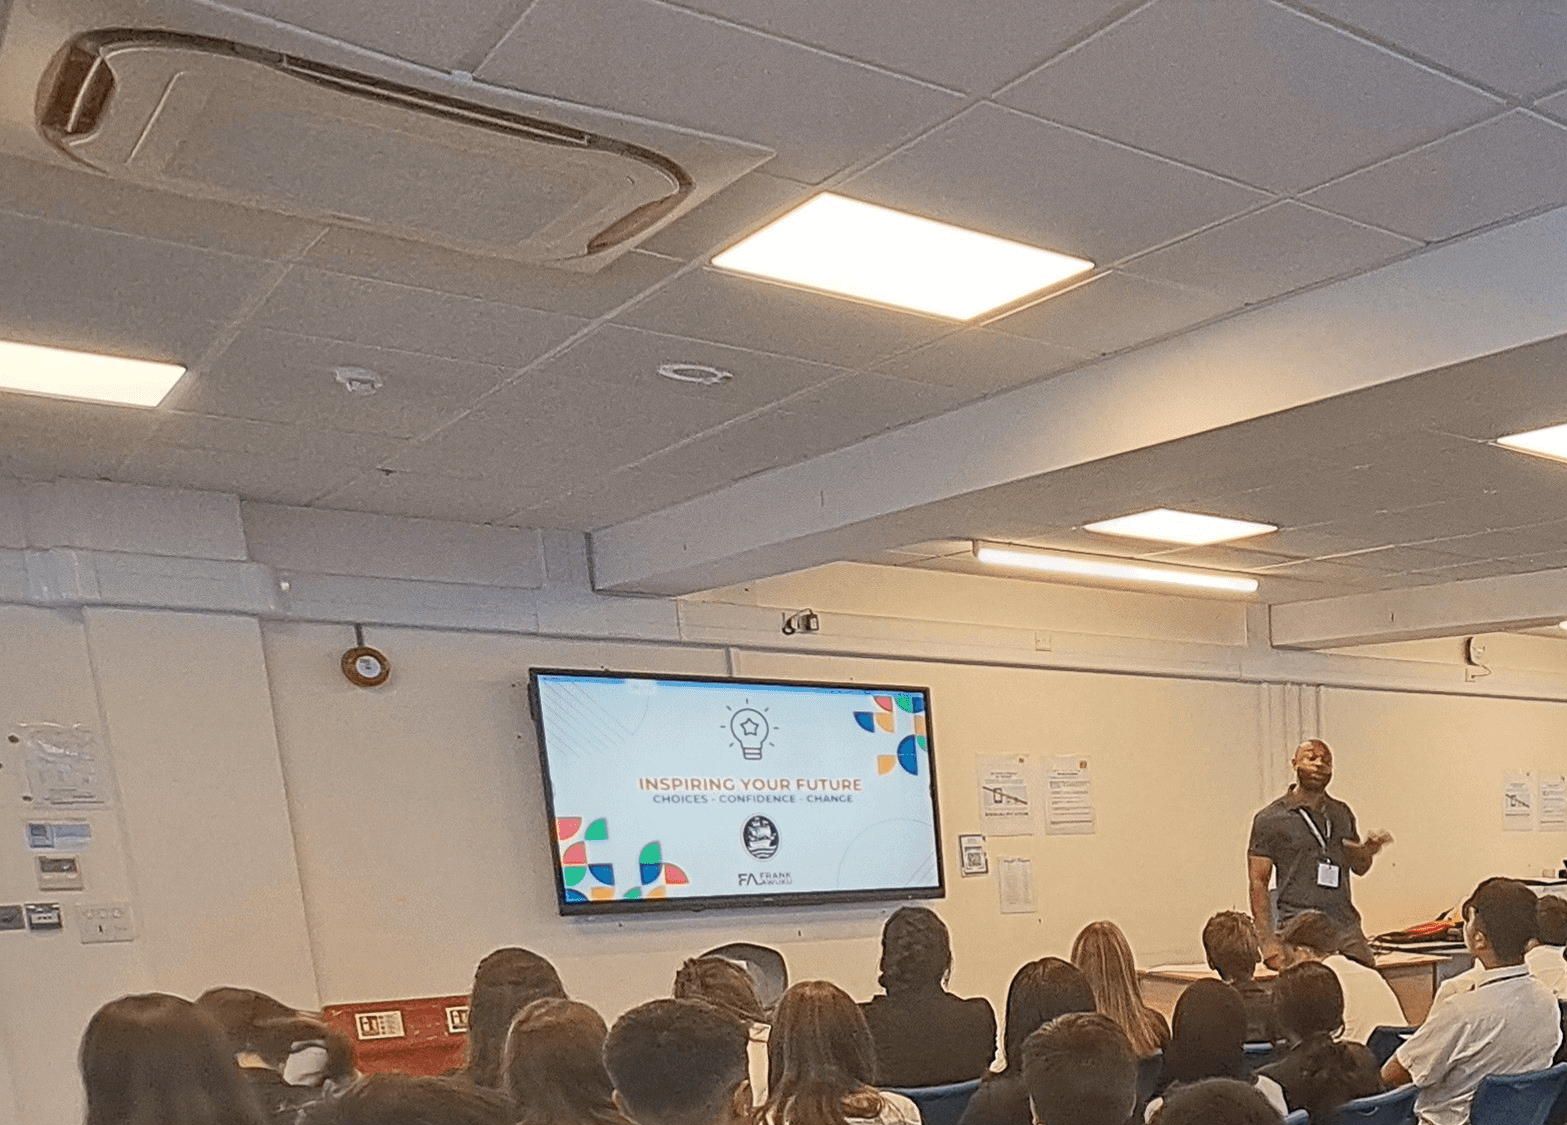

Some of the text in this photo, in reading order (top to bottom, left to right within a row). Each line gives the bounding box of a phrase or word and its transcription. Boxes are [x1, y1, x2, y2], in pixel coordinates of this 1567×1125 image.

[638, 777, 862, 791] INSPIRING YOUR FUTURE
[652, 794, 853, 804] CHOICES CONFIDENCE CHANGE
